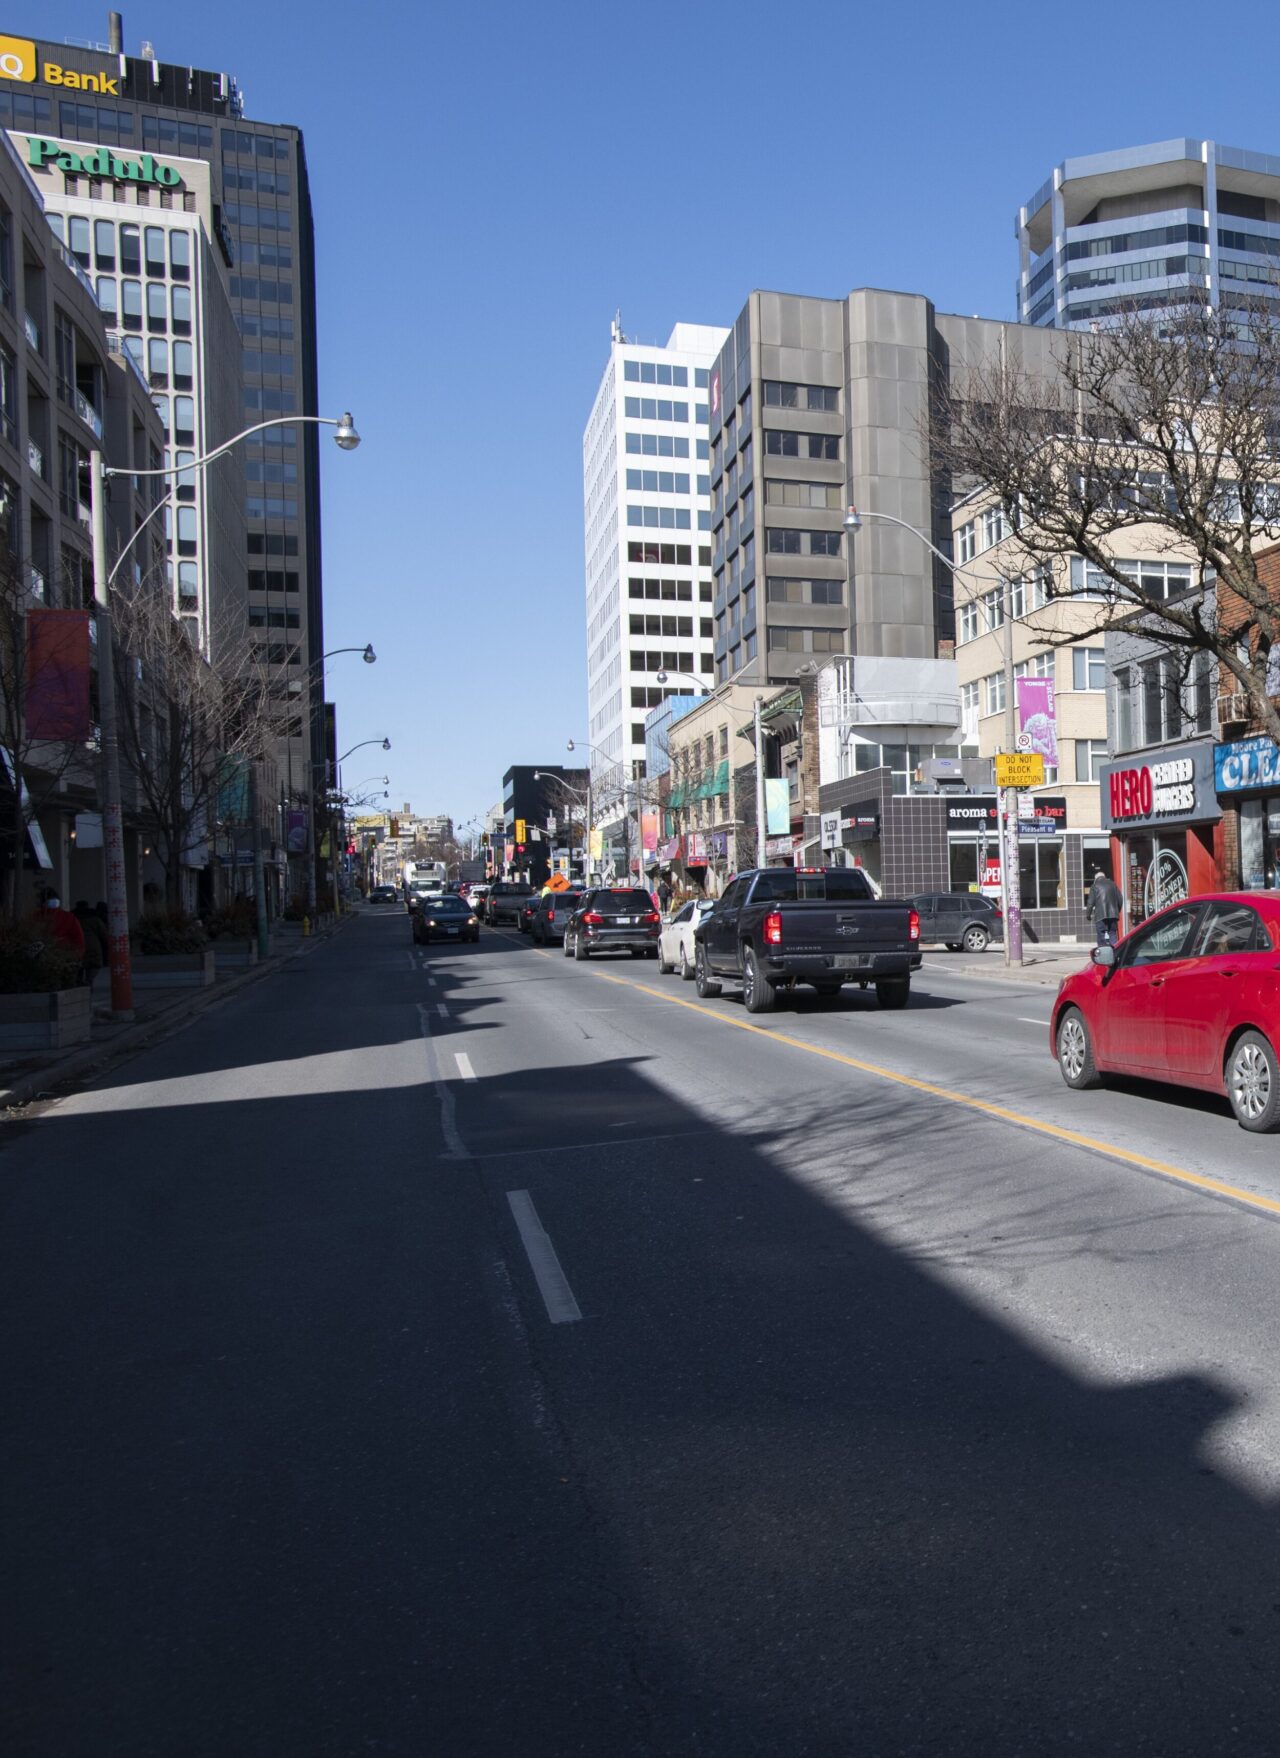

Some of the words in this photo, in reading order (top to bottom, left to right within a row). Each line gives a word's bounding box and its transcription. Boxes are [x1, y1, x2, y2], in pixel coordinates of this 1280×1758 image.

[44, 62, 119, 96] Bank
[26, 136, 181, 186] Padulo
[1231, 741, 1258, 754] Moore
[1005, 756, 1015, 764] DO
[1019, 756, 1032, 764] NOT
[1008, 766, 1031, 775] BLOCK
[1152, 758, 1193, 787] CERTIFIED
[999, 776, 1042, 785] INTERSECTION
[1110, 764, 1152, 818] HERO
[1153, 783, 1194, 812] BURGERS
[949, 808, 987, 818] aroma
[1044, 805, 1064, 817] bar
[1021, 825, 1046, 833] Pleasant
